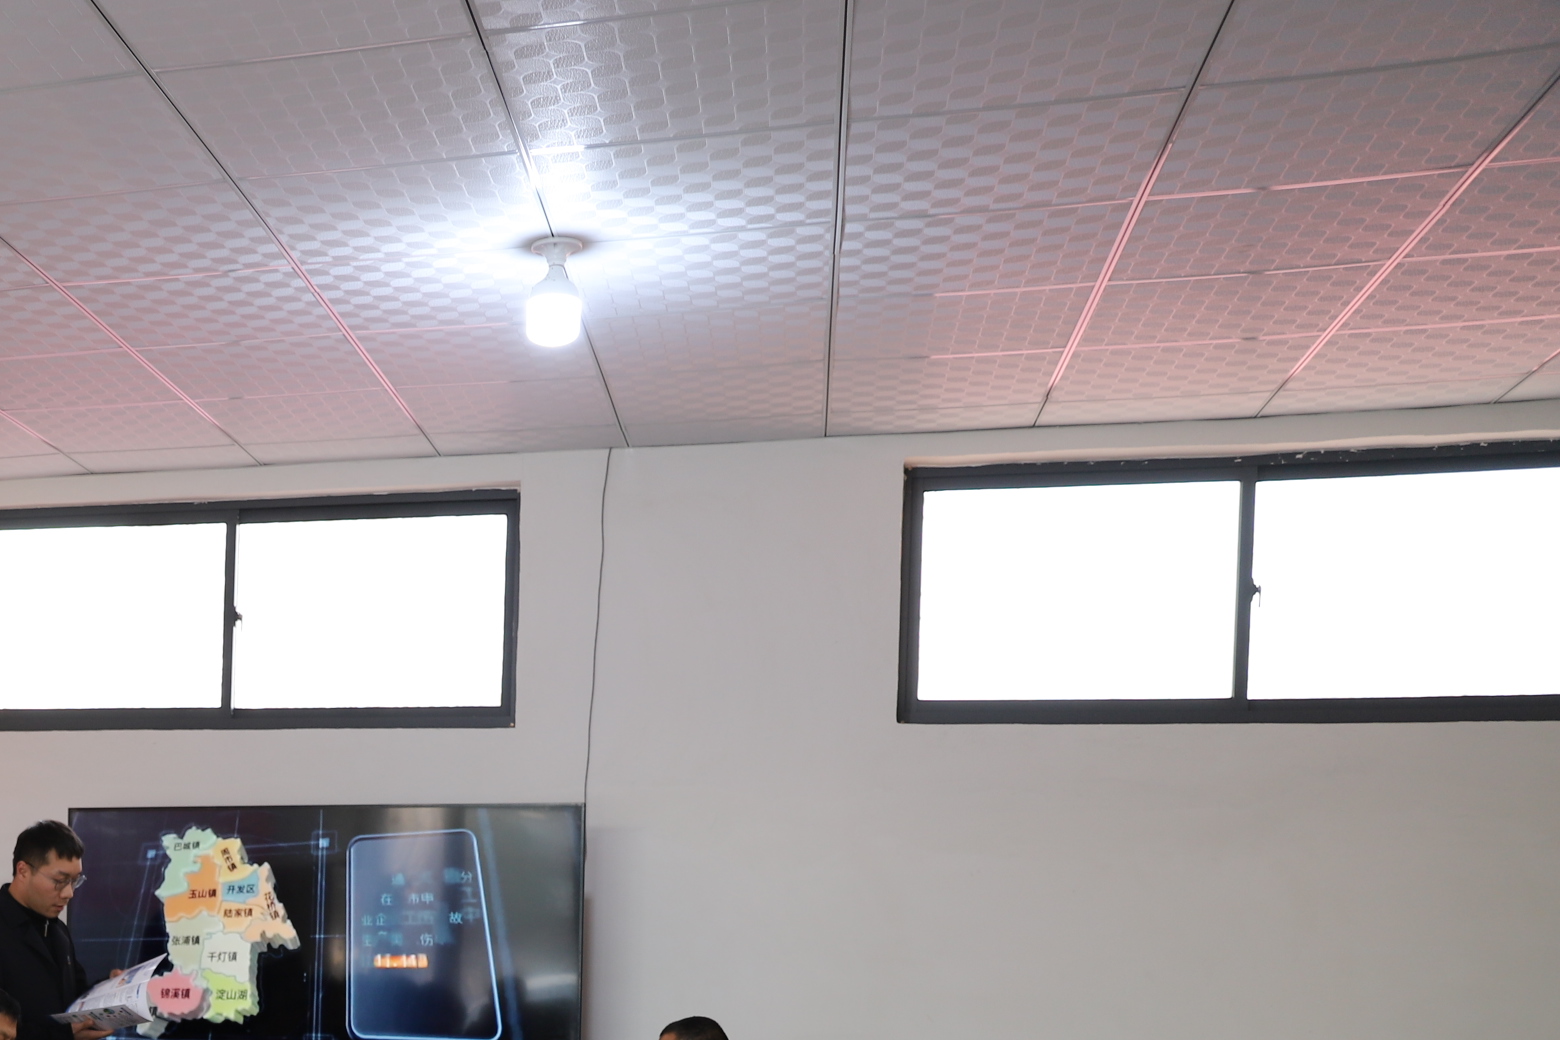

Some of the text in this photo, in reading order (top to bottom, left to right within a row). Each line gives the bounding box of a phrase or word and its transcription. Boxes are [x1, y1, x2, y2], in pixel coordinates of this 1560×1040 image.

[174, 841, 200, 851] 巴城镇
[188, 888, 217, 899] 玉山镇
[226, 884, 255, 894] 开发区
[223, 908, 253, 918] 陆家镇
[171, 935, 200, 945] 张浦镇
[207, 951, 237, 962] 千灯镇
[160, 988, 191, 999] 锦溪镇
[215, 989, 248, 1000] 淀山湖
